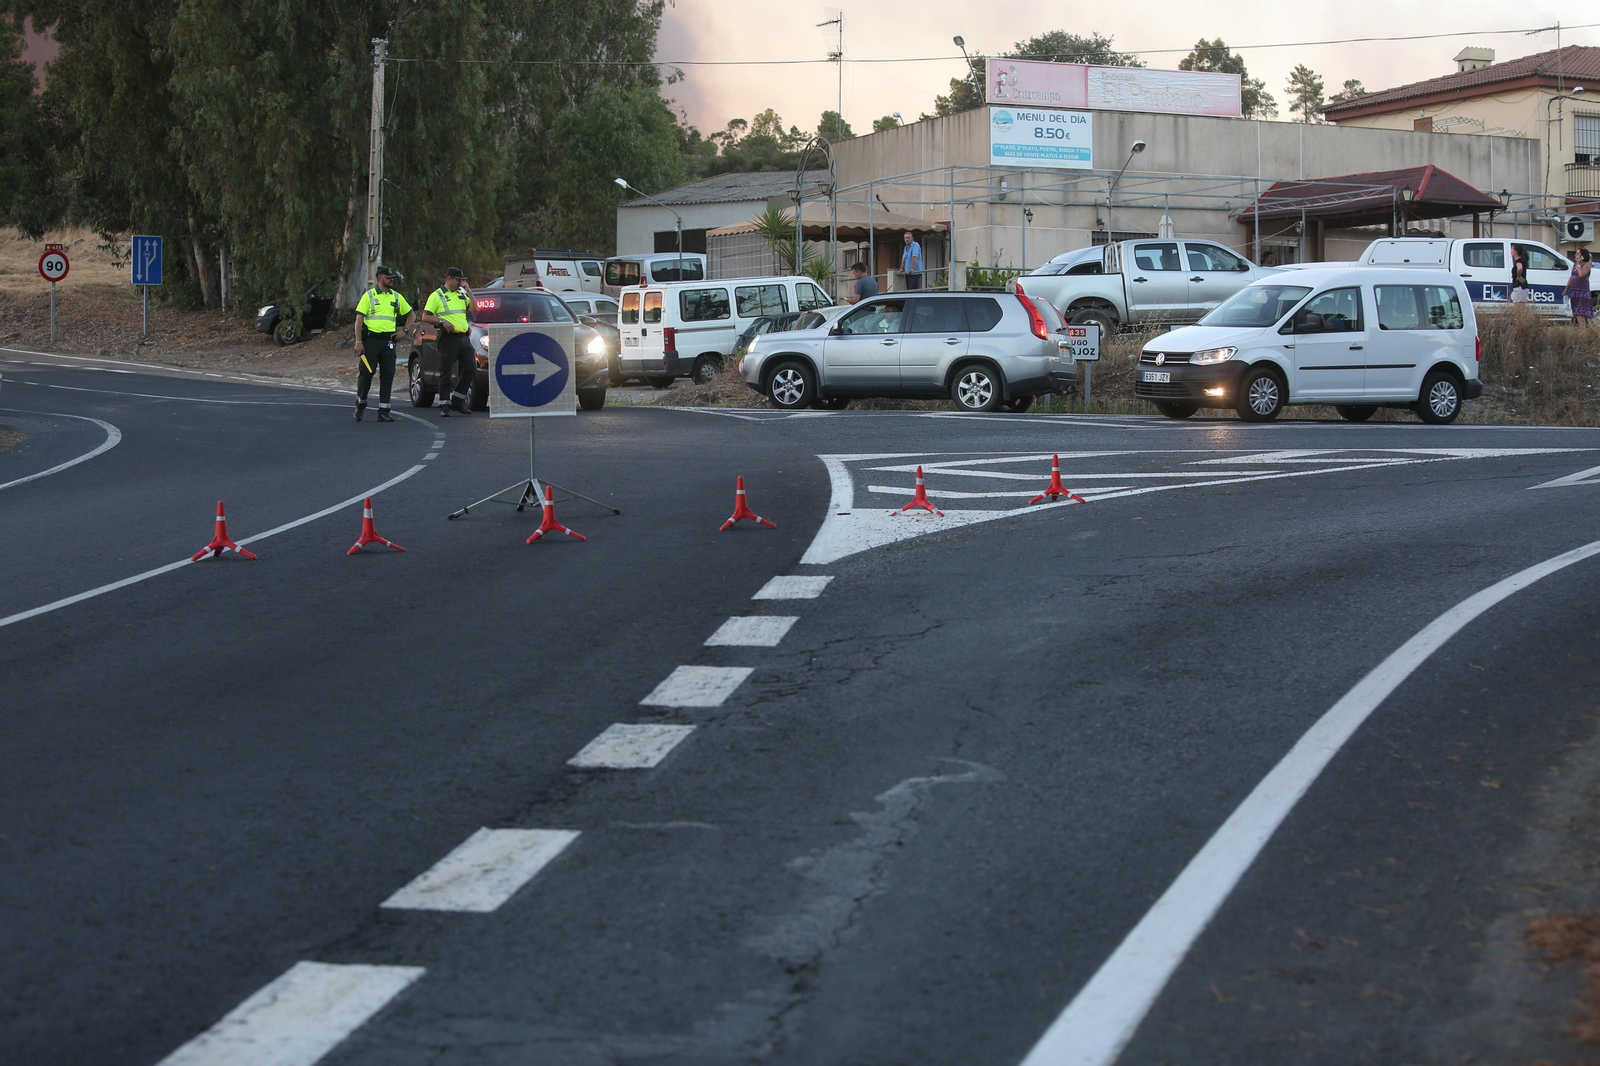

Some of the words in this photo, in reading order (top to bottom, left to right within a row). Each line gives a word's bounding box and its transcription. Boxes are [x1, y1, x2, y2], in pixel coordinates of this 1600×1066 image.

[1012, 88, 1060, 103] Cruzcampo
[1016, 112, 1046, 122] MENÚ
[1049, 114, 1067, 123] DEL
[1070, 114, 1087, 124] DÍA
[46, 261, 63, 271] 90
[1527, 289, 1554, 302] desa
[1145, 373, 1157, 381] 6351
[1159, 373, 1169, 381] JZY
